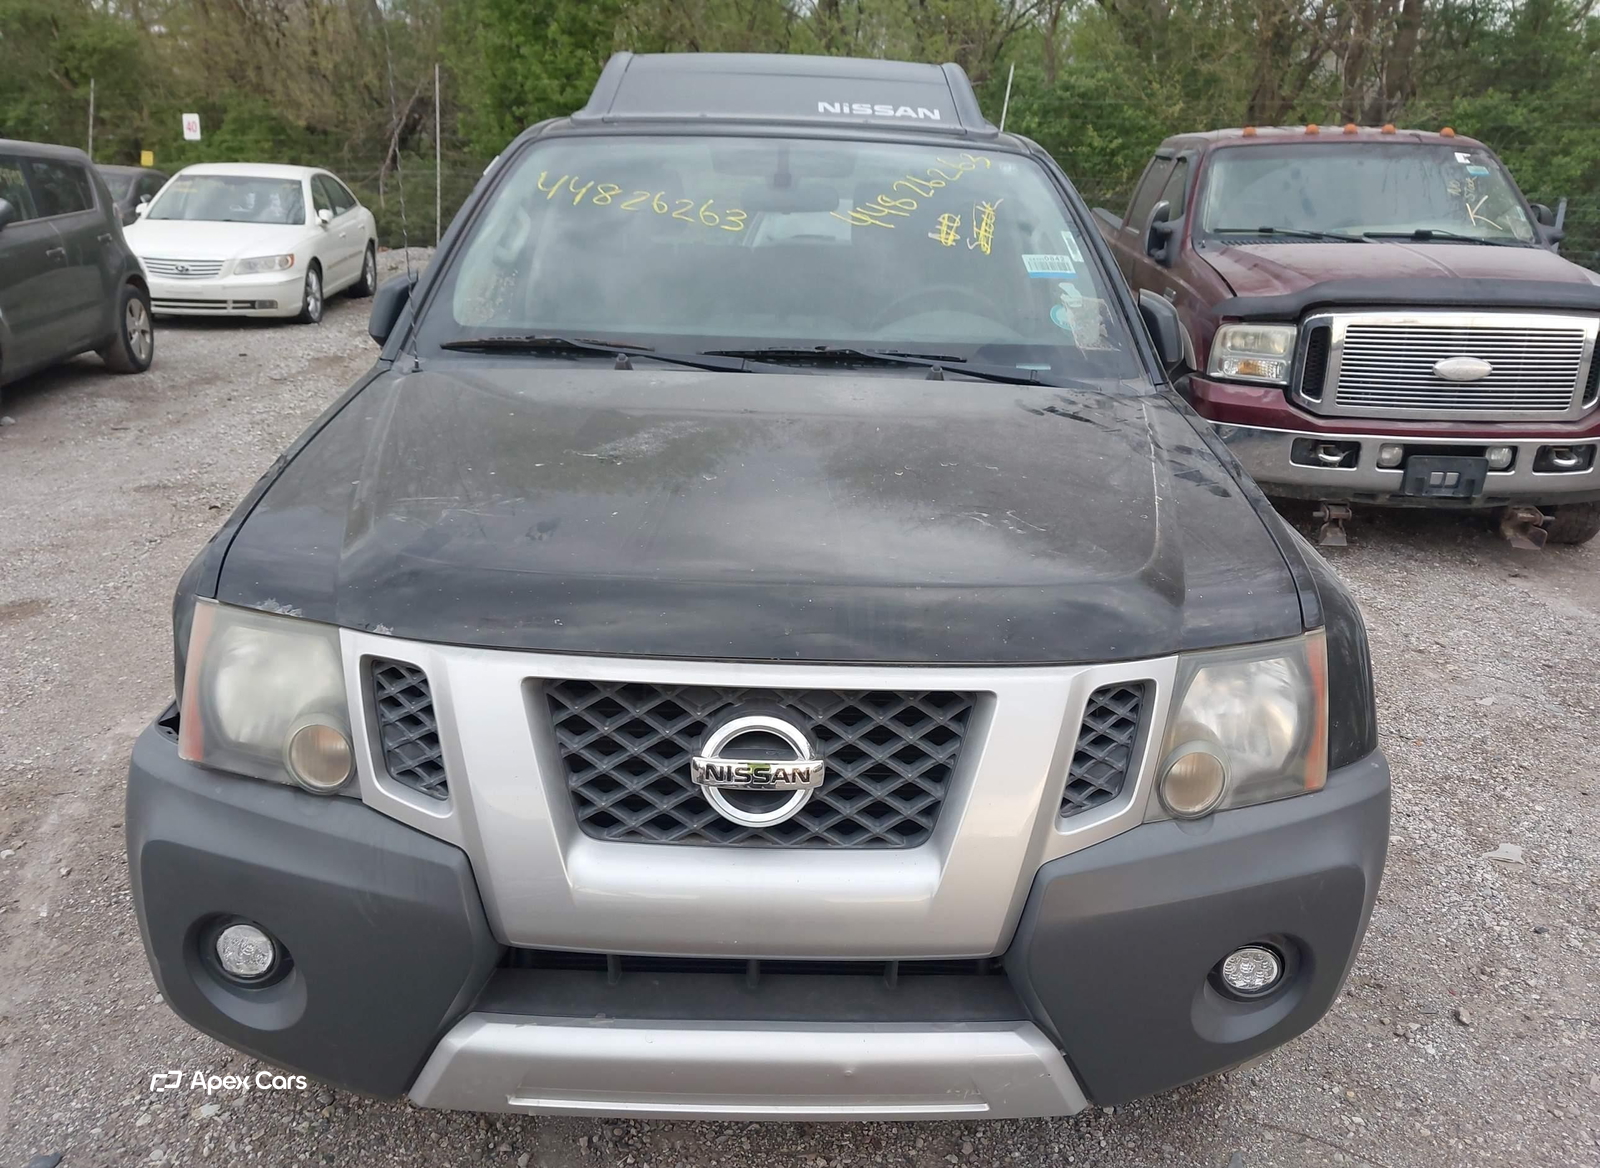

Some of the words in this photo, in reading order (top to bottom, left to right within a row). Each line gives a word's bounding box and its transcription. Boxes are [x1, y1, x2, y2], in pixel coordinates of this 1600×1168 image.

[537, 170, 748, 231] 44826263
[829, 152, 992, 229] 44826263
[1465, 194, 1503, 230] K
[704, 763, 811, 784] NISSAN
